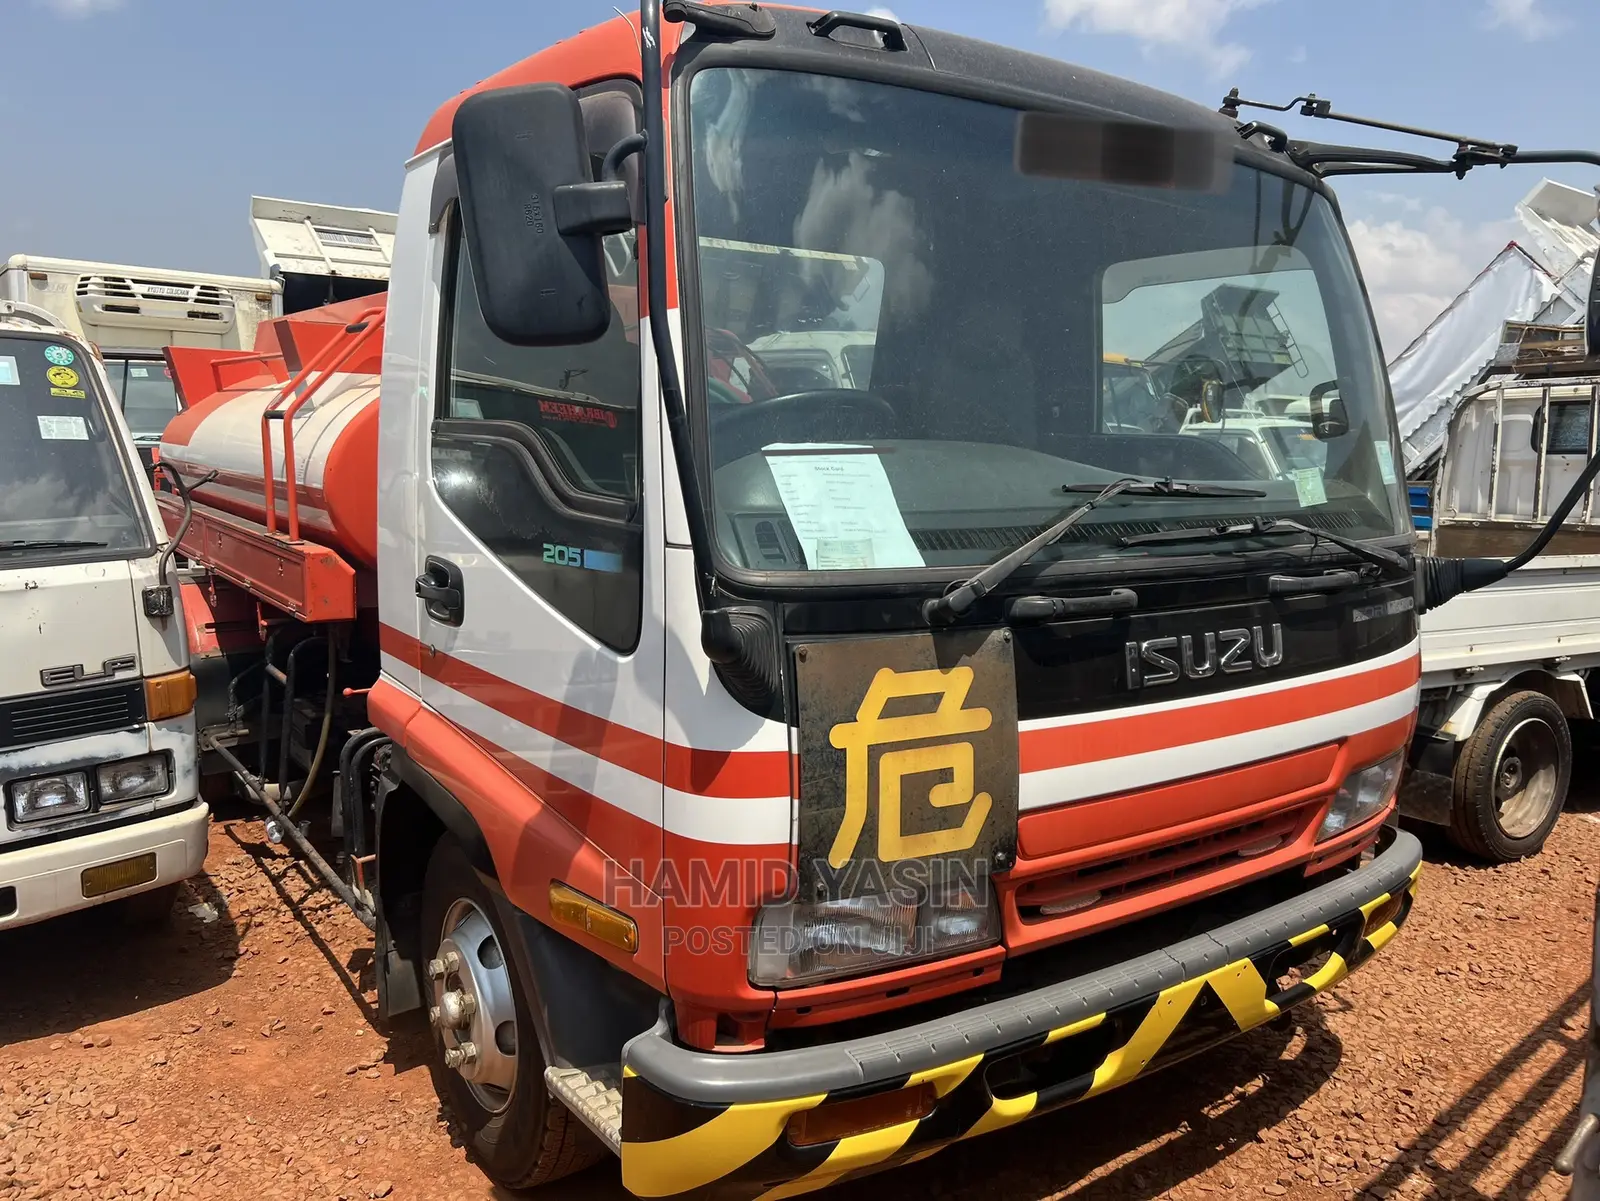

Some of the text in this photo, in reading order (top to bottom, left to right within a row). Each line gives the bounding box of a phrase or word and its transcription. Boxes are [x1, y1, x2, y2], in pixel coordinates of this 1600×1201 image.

[543, 543, 581, 567] 205
[40, 653, 137, 687] ELF
[1125, 623, 1284, 690] ISUZU
[828, 666, 992, 869] 危
